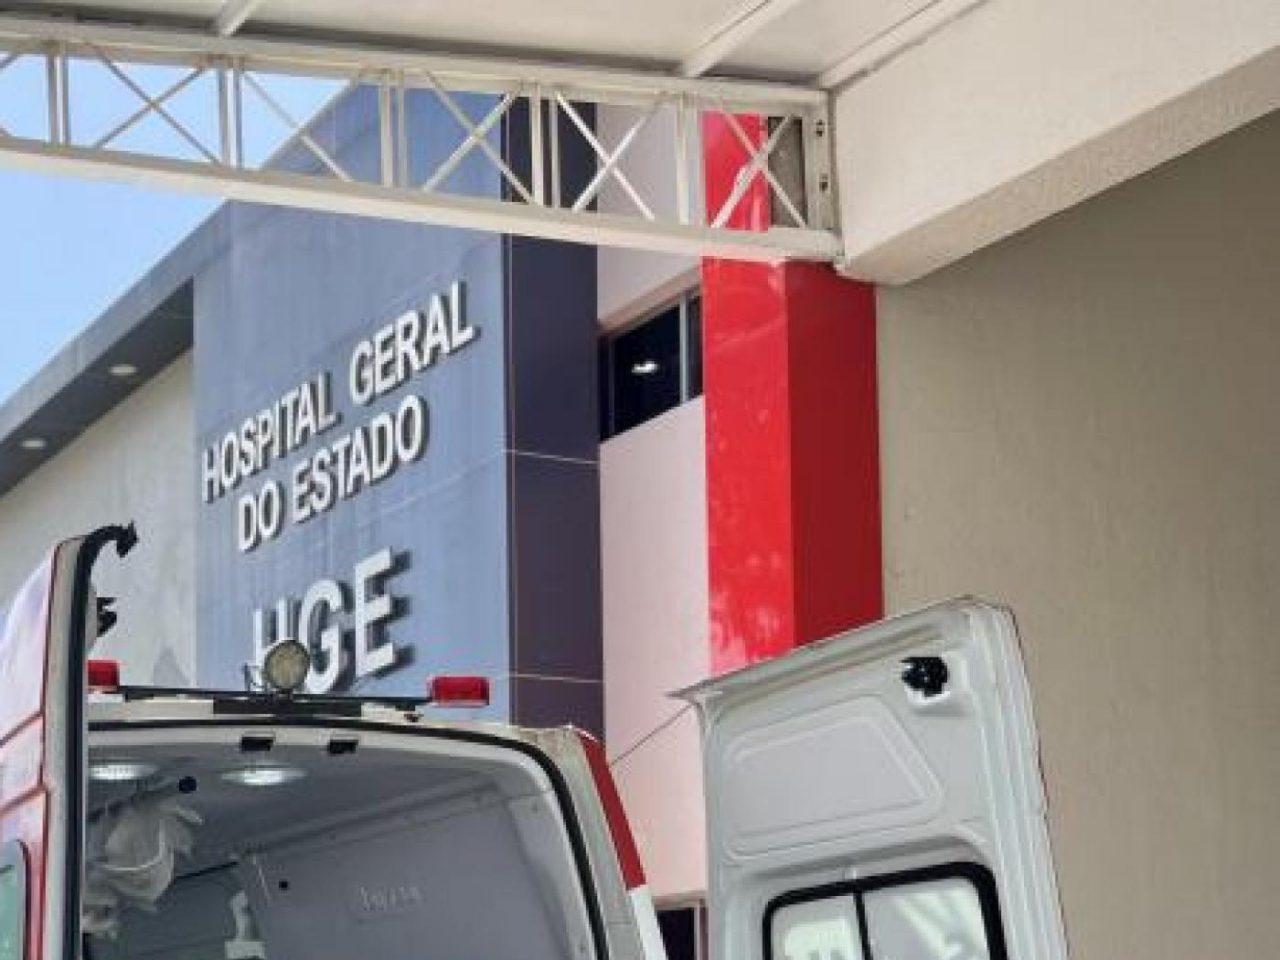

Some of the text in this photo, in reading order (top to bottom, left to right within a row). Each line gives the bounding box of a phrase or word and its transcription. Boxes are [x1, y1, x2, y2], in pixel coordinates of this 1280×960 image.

[202, 279, 476, 503] HOSPITAL GERAL
[237, 394, 426, 552] DO ESTADO
